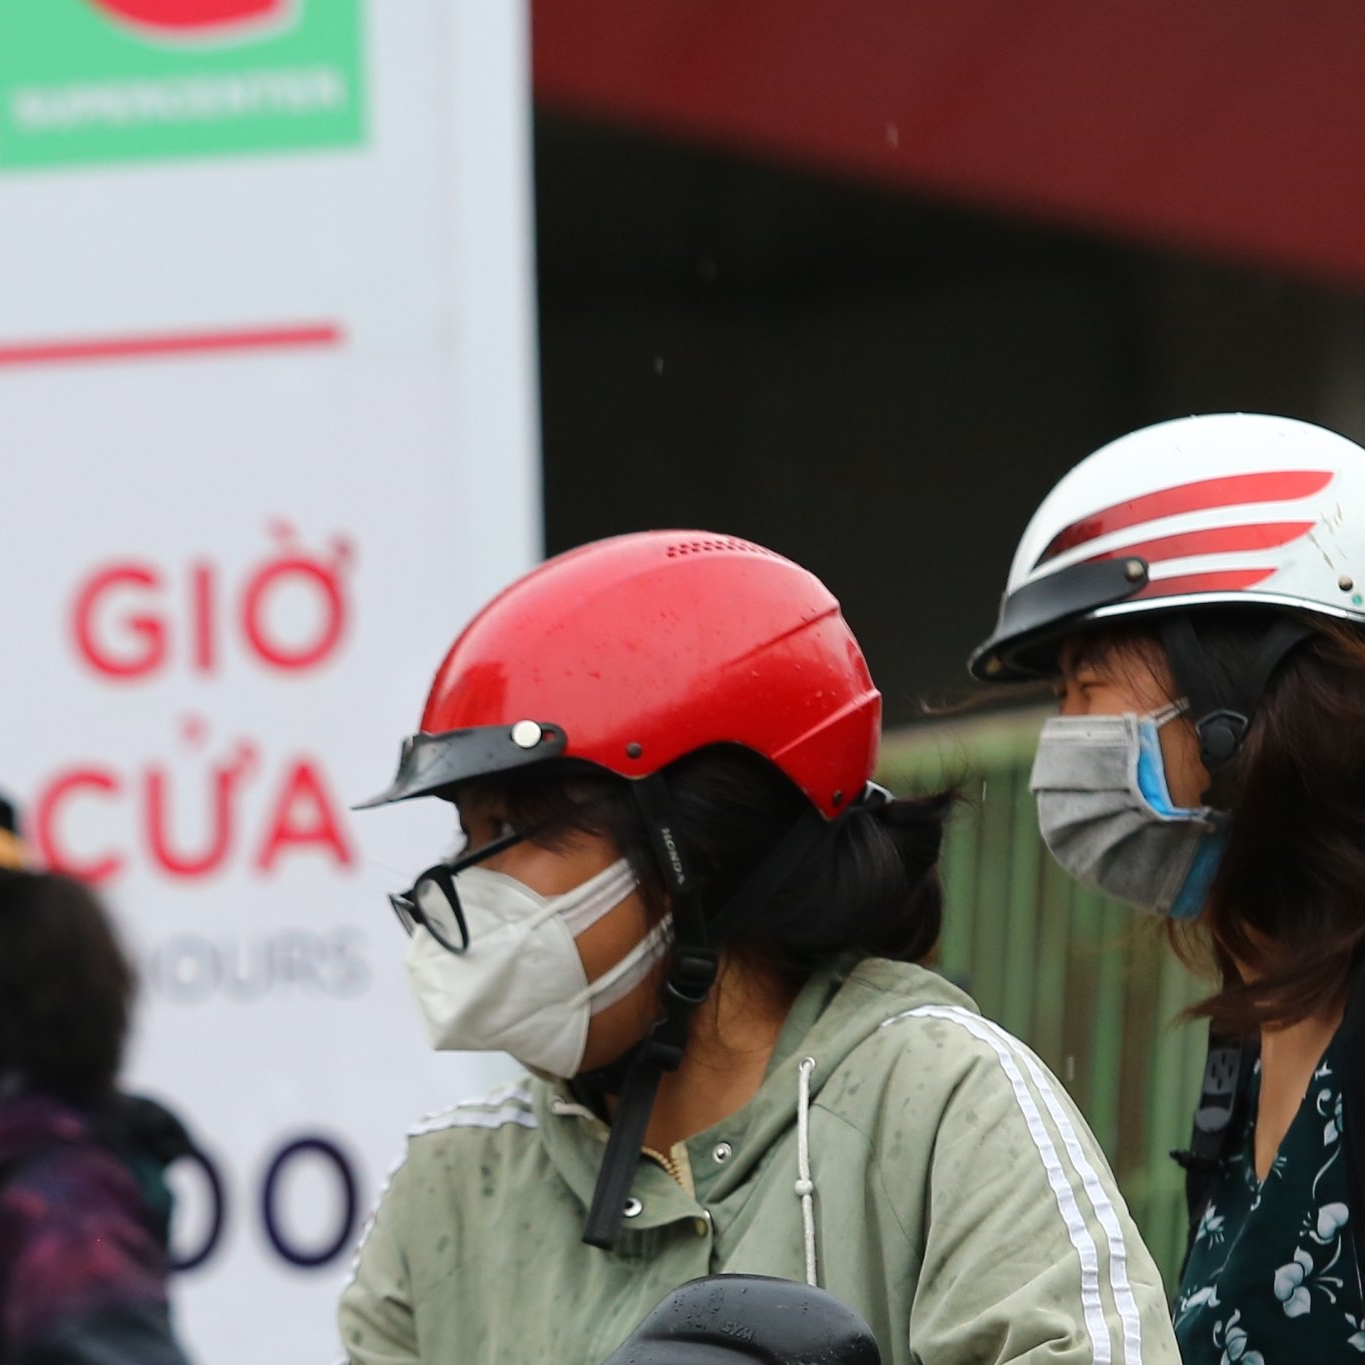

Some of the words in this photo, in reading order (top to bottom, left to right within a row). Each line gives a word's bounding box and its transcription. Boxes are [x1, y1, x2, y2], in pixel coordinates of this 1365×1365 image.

[70, 518, 354, 681] GIỜ
[33, 712, 357, 885] CỬA
[660, 827, 686, 885] HONDA
[139, 925, 371, 1004] OURS
